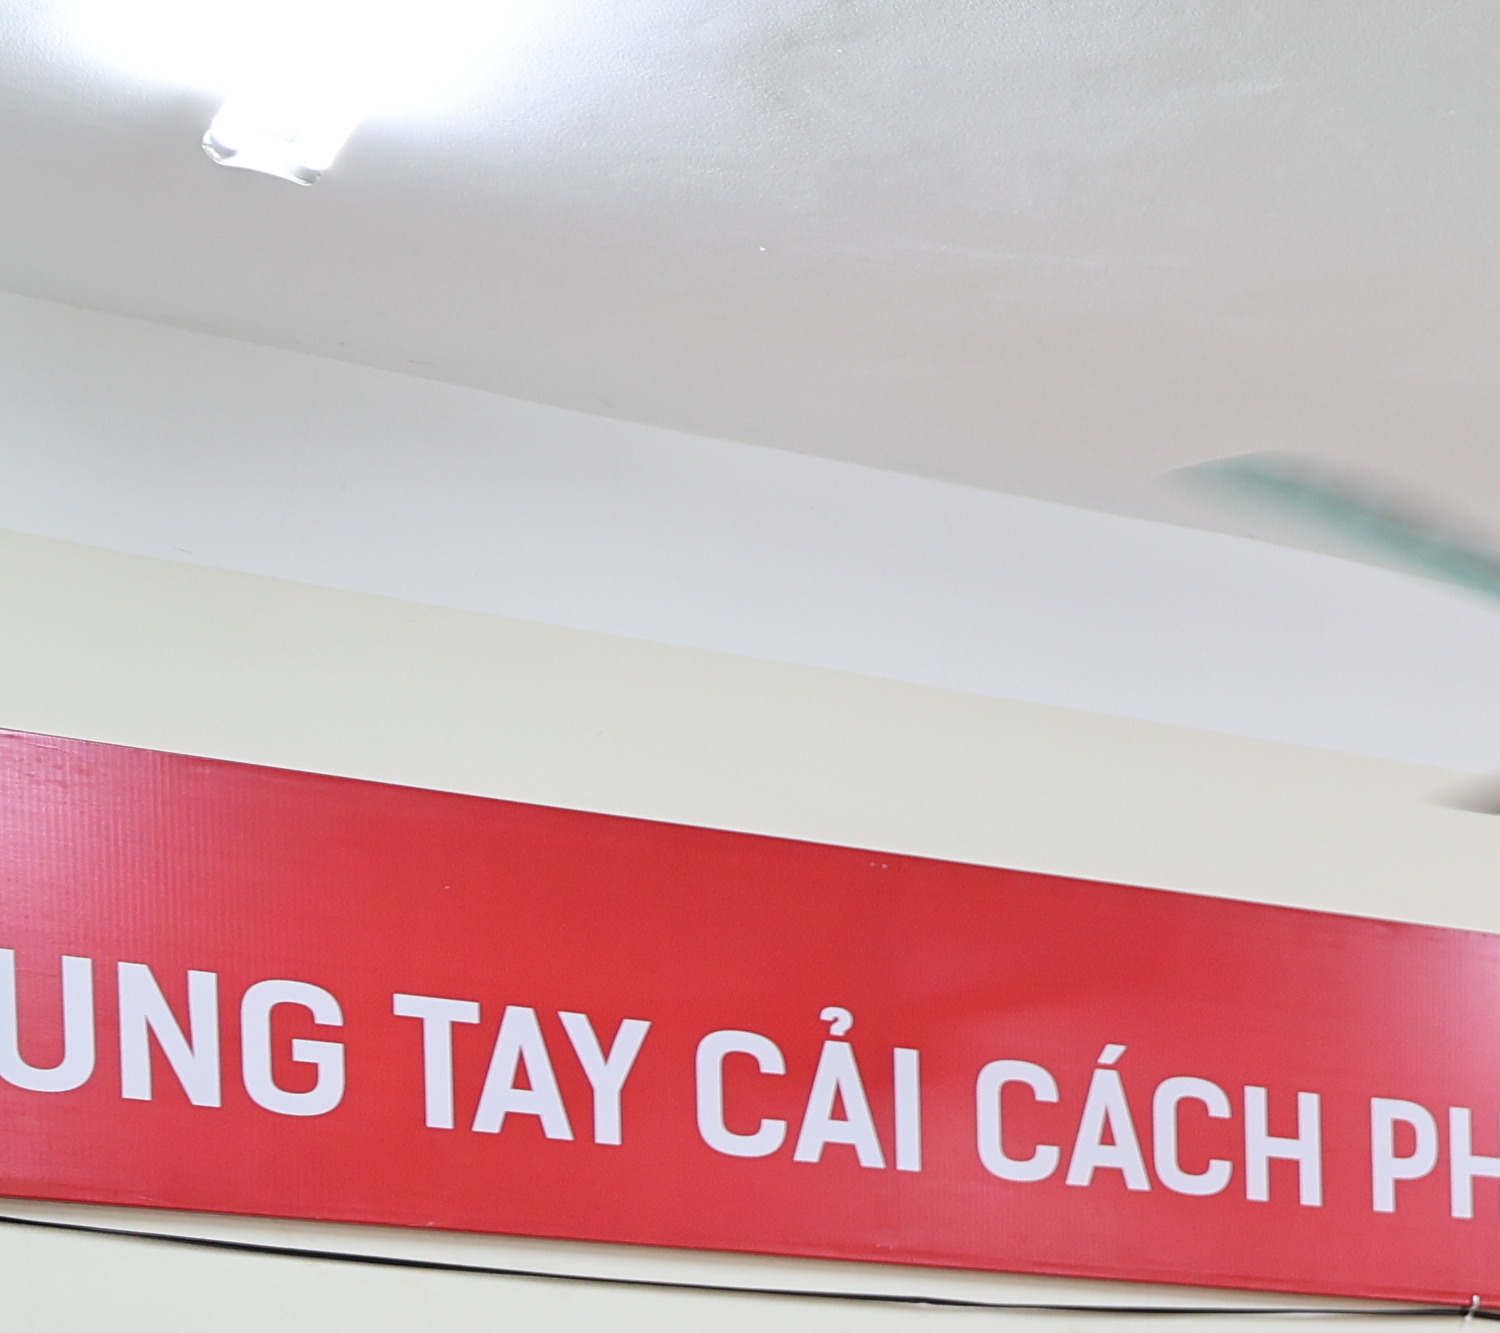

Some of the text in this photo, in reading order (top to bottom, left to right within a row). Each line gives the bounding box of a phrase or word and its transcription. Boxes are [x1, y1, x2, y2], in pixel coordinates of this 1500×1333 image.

[393, 992, 652, 1146] TAY
[694, 1007, 923, 1174] CẢI
[974, 1045, 1323, 1207] CÁCH
